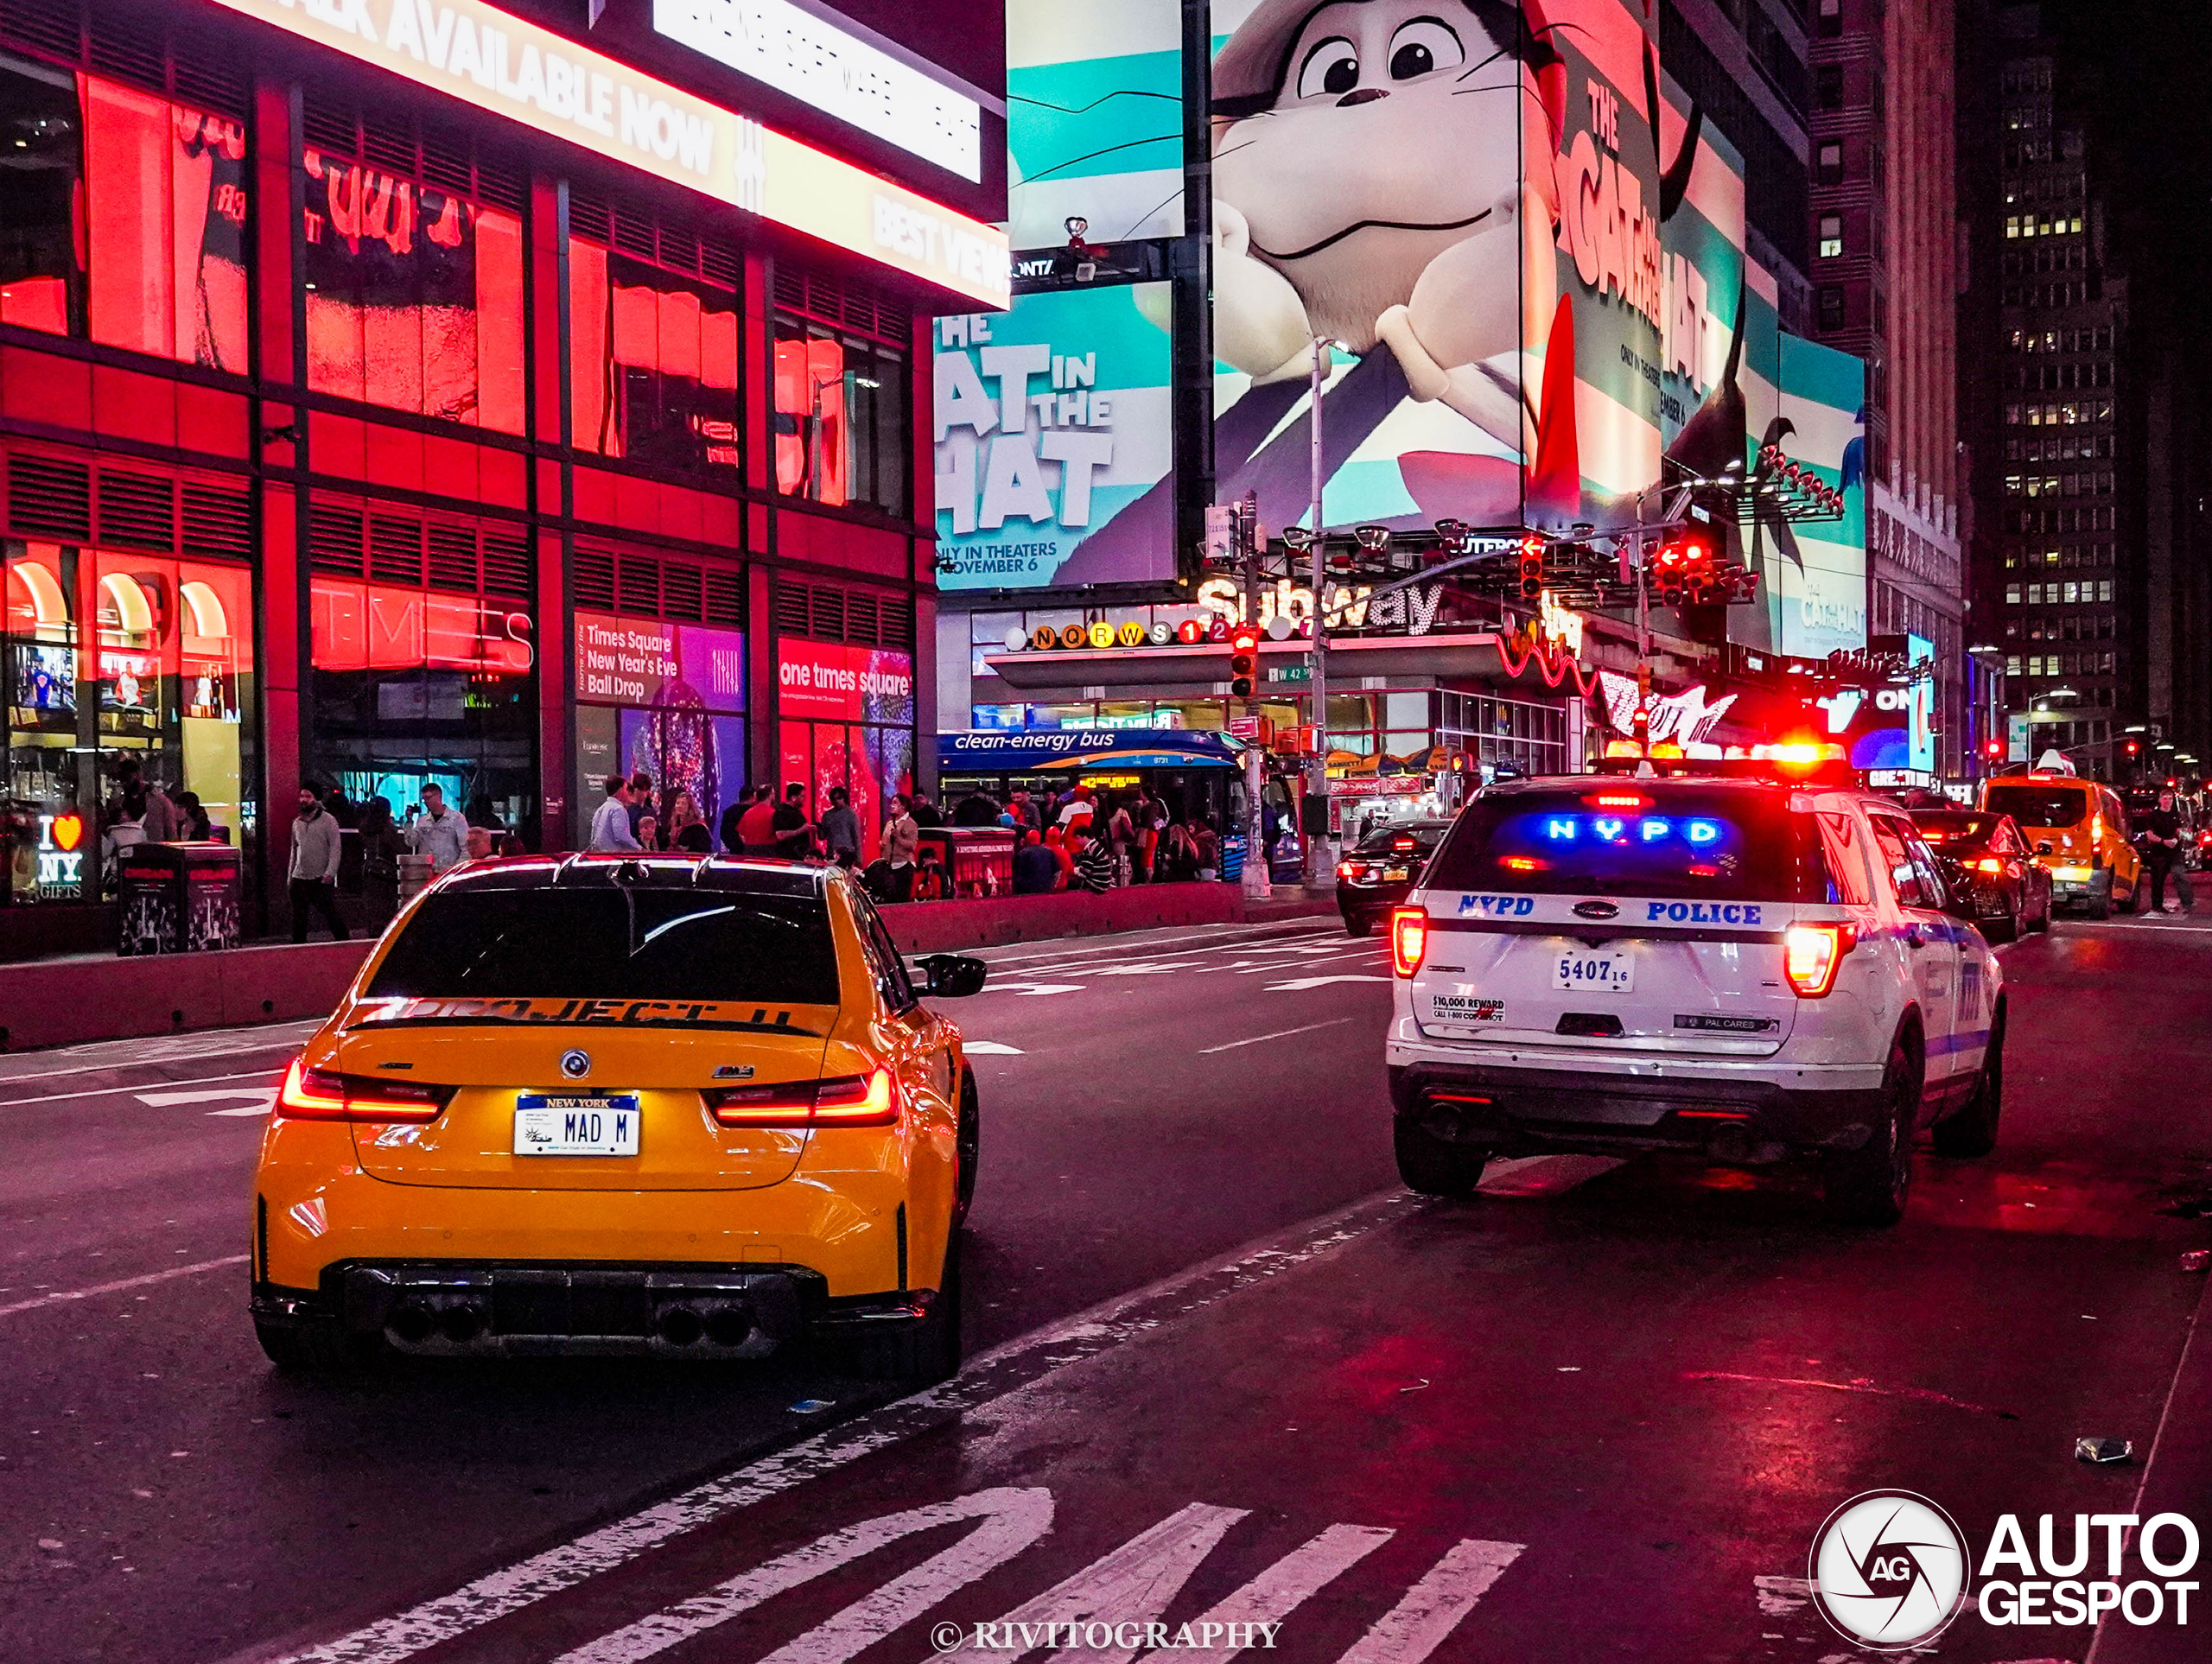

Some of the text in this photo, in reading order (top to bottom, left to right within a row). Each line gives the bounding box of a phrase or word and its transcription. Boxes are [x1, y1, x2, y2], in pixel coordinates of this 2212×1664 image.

[386, 0, 614, 137] AVAILABLE
[620, 85, 715, 175] NOW
[1587, 78, 1619, 153] THE
[874, 194, 939, 266] BEST
[1568, 130, 1641, 305] CAT
[940, 314, 992, 346] HE
[1051, 352, 1096, 389] IN
[934, 344, 1050, 443] AT
[1031, 391, 1113, 427] THE
[966, 546, 982, 560] IN
[986, 543, 1057, 559] THEATERS
[1027, 558, 1038, 572] 6
[1198, 579, 1445, 636] Subway
[311, 587, 534, 669] TIMES
[588, 624, 672, 657] Times Square
[1037, 631, 1051, 645] N
[1065, 629, 1080, 643] Q
[1122, 628, 1140, 643] W
[1152, 626, 1167, 642] S
[588, 650, 677, 676] New Year's Eve
[1279, 670, 1287, 681] W
[1290, 669, 1300, 680] 42
[588, 675, 645, 703] Ball Drop
[780, 662, 909, 706] one times square
[955, 731, 1115, 752] clean-energy bus
[38, 815, 54, 850] I
[1549, 820, 1717, 842] NYPD
[40, 883, 82, 899] GIFTS
[1458, 894, 1535, 917] NYPD
[1647, 901, 1762, 925] POLICE
[1560, 960, 1628, 982] 5407 16
[1433, 995, 1504, 1010] $10,000 REWARD
[1705, 1019, 1755, 1029] PAL CARES
[546, 1098, 610, 1108] NEW YORK
[565, 1114, 601, 1142] MAD
[616, 1114, 627, 1143] M
